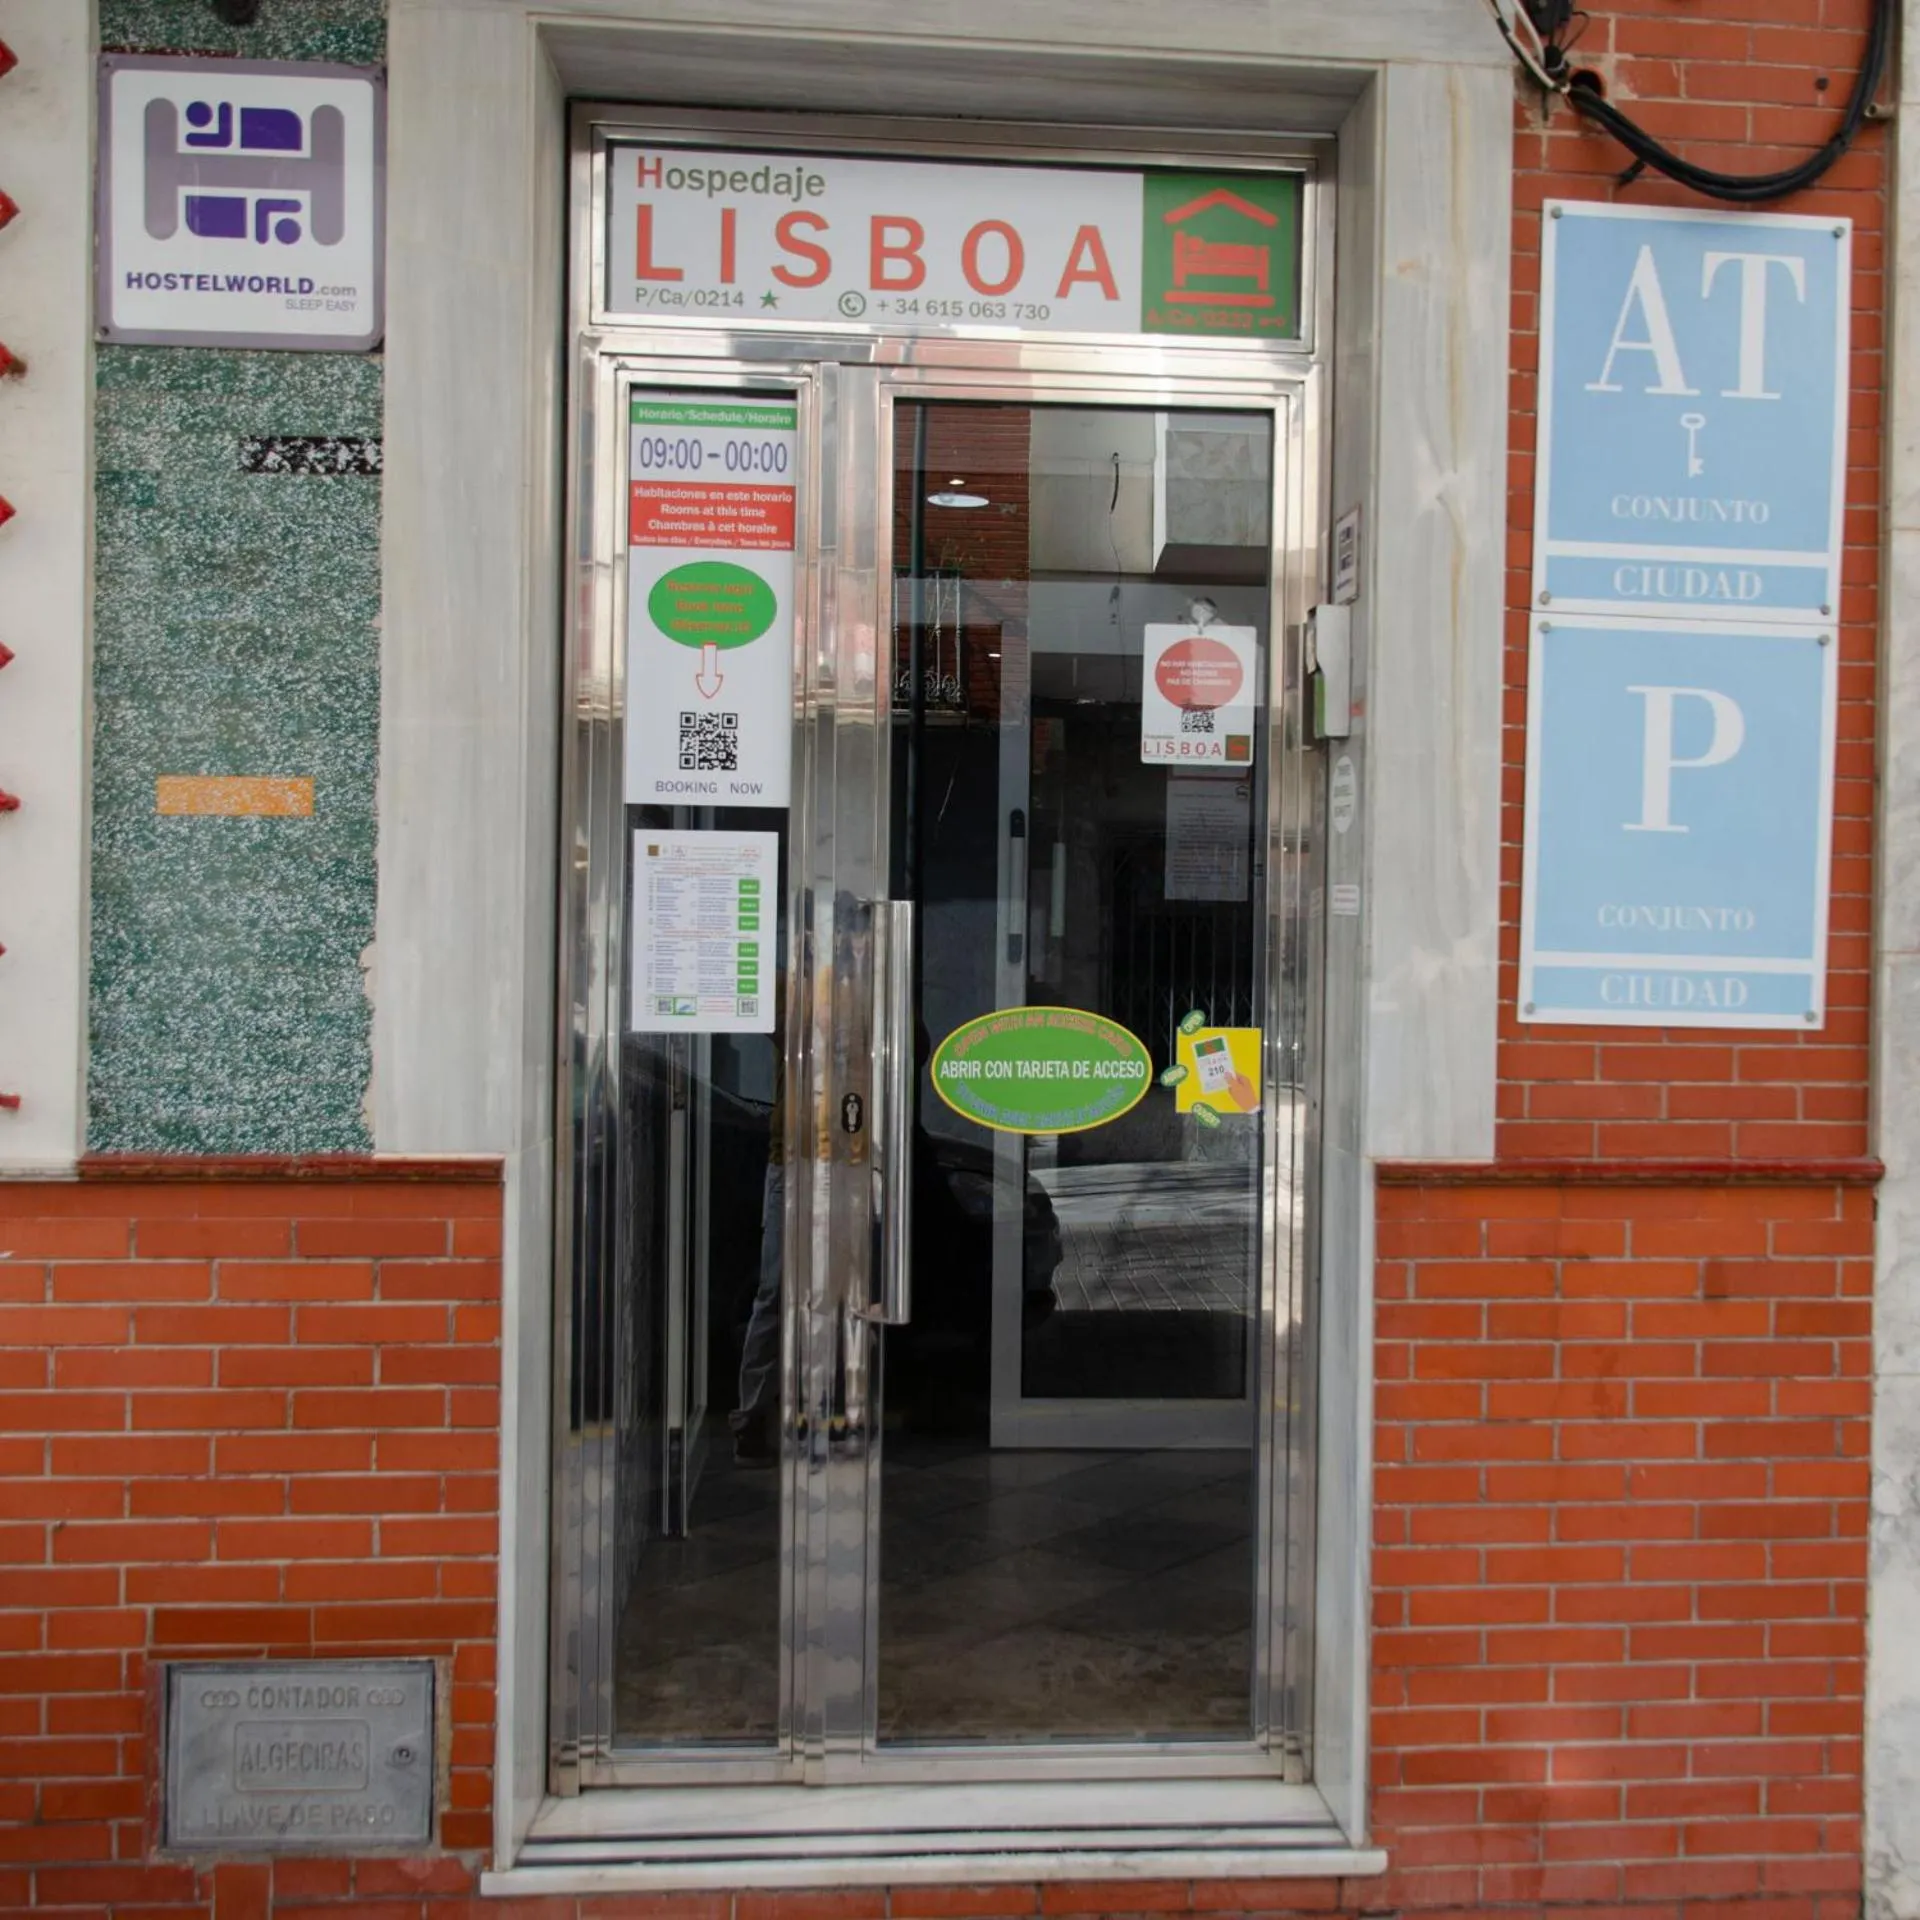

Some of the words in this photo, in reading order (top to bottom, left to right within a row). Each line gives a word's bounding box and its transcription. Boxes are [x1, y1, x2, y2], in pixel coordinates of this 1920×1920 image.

[637, 156, 826, 202] Hospedaje
[636, 203, 1121, 301] LISBOA
[126, 271, 357, 297] HOSTELWORLD.com
[635, 286, 744, 308] P/Ca/0214
[285, 299, 324, 311] SLEEP
[326, 300, 357, 312] EASY
[895, 298, 920, 316] 34
[926, 300, 964, 318] 615
[968, 301, 1007, 319] 063
[1014, 303, 1051, 321] 730
[1584, 244, 1805, 400] AT
[640, 437, 702, 470] 09:00
[725, 440, 788, 473] 00:00
[634, 487, 706, 500] Habitaciones
[709, 490, 724, 500] en
[752, 491, 793, 503] horario
[660, 503, 700, 515] Rooms
[703, 506, 715, 516] at
[716, 505, 738, 517] this
[740, 506, 766, 518] time
[1611, 494, 1770, 524] CONJUNTO
[647, 519, 706, 531] Chambres
[738, 523, 778, 535] horaire
[1613, 565, 1763, 600] CIUDAD
[1143, 740, 1222, 756] LISBOA
[1620, 684, 1746, 834] P
[655, 780, 718, 795] BOOKING
[730, 782, 763, 795] NOW
[1597, 903, 1757, 932] CONJUNTO
[1600, 973, 1749, 1008] CIUDAD
[940, 1060, 983, 1079] ABRIR
[985, 1061, 1014, 1079] CON
[1016, 1060, 1071, 1079] TARJETA
[1073, 1060, 1091, 1079] DE
[1094, 1060, 1146, 1080] ACCESO
[249, 1685, 361, 1709] CONTADOR
[239, 1740, 365, 1773] ALGECIRAS
[203, 1803, 281, 1830] LLAVE
[289, 1803, 323, 1828] DE
[330, 1803, 396, 1828] PASO
